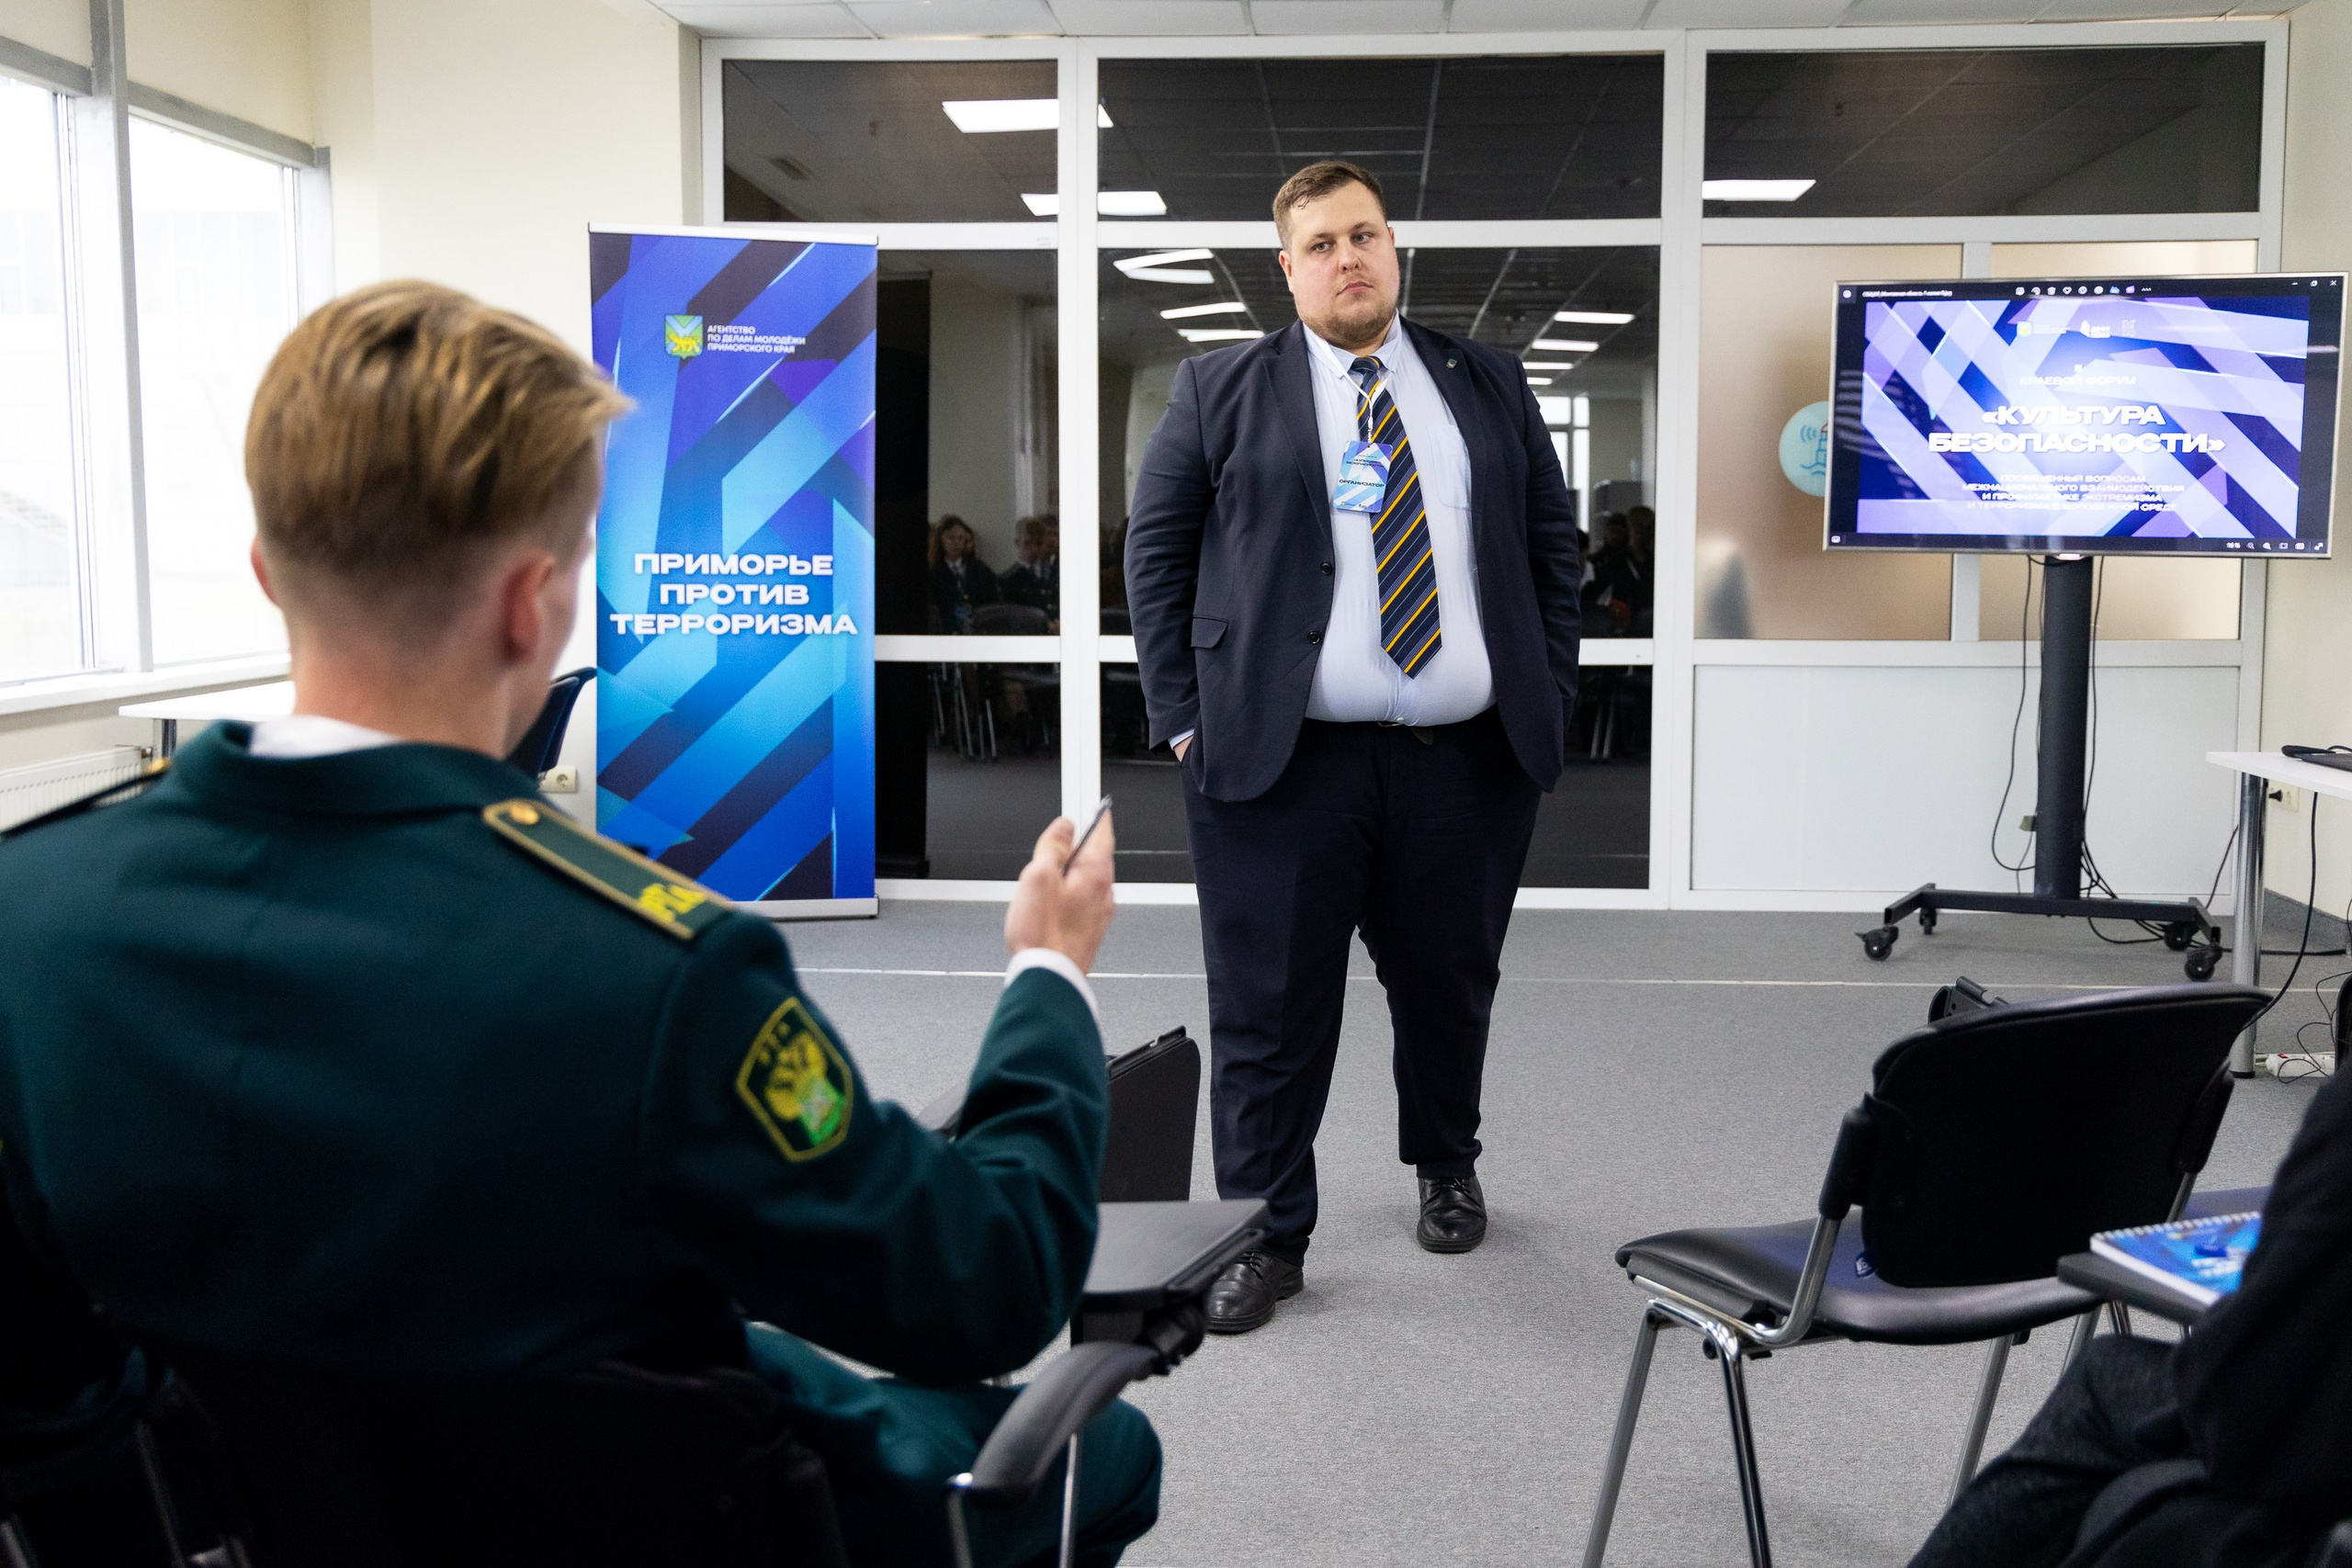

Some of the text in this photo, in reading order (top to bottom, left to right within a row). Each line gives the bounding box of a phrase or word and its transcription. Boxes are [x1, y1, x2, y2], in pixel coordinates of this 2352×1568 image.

[707, 325, 755, 334] АГЕНТСТВО
[707, 333, 721, 343] ПО
[721, 334, 753, 344] ДЕЛАМ
[707, 343, 796, 354] ПРИМОРСКОГО КРАЯ
[634, 553, 834, 576] ПРИМОРЬЕ
[660, 583, 809, 605] ПРОТИВ
[609, 614, 858, 635] ТЕРРОРИЗМА
